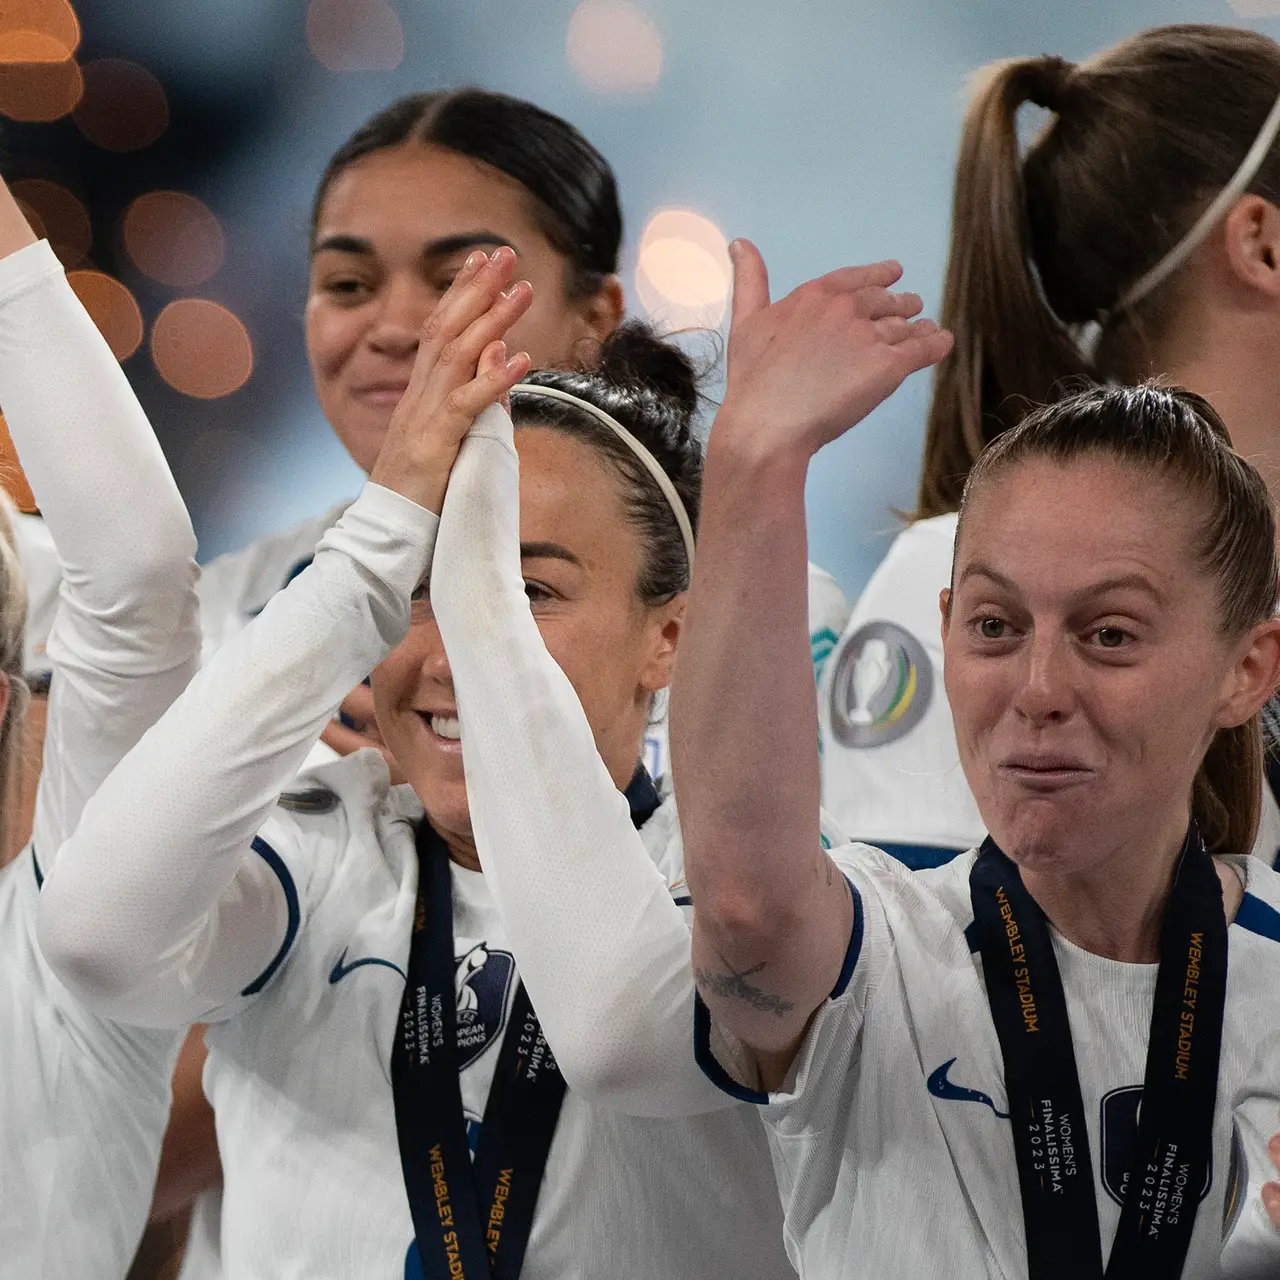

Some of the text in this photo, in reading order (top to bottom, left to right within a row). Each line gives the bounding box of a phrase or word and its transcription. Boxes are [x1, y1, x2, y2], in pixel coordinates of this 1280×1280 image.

[995, 886, 1040, 1033] WEMBLEY STADIUM
[403, 1010, 416, 1050] 2023
[1174, 932, 1205, 1080] WEMBLEY STADIUM
[457, 1023, 486, 1039] PEAN
[457, 1033, 487, 1048] PIONS
[517, 1011, 537, 1055] 2023
[526, 1031, 547, 1081] ISSIMA
[1029, 1124, 1045, 1170] 2023
[1059, 1113, 1077, 1176] WOMEN'S
[428, 1143, 454, 1227] WEMBLEY
[1140, 1163, 1158, 1210] 2023
[1167, 1163, 1190, 1225] WOMEN'S
